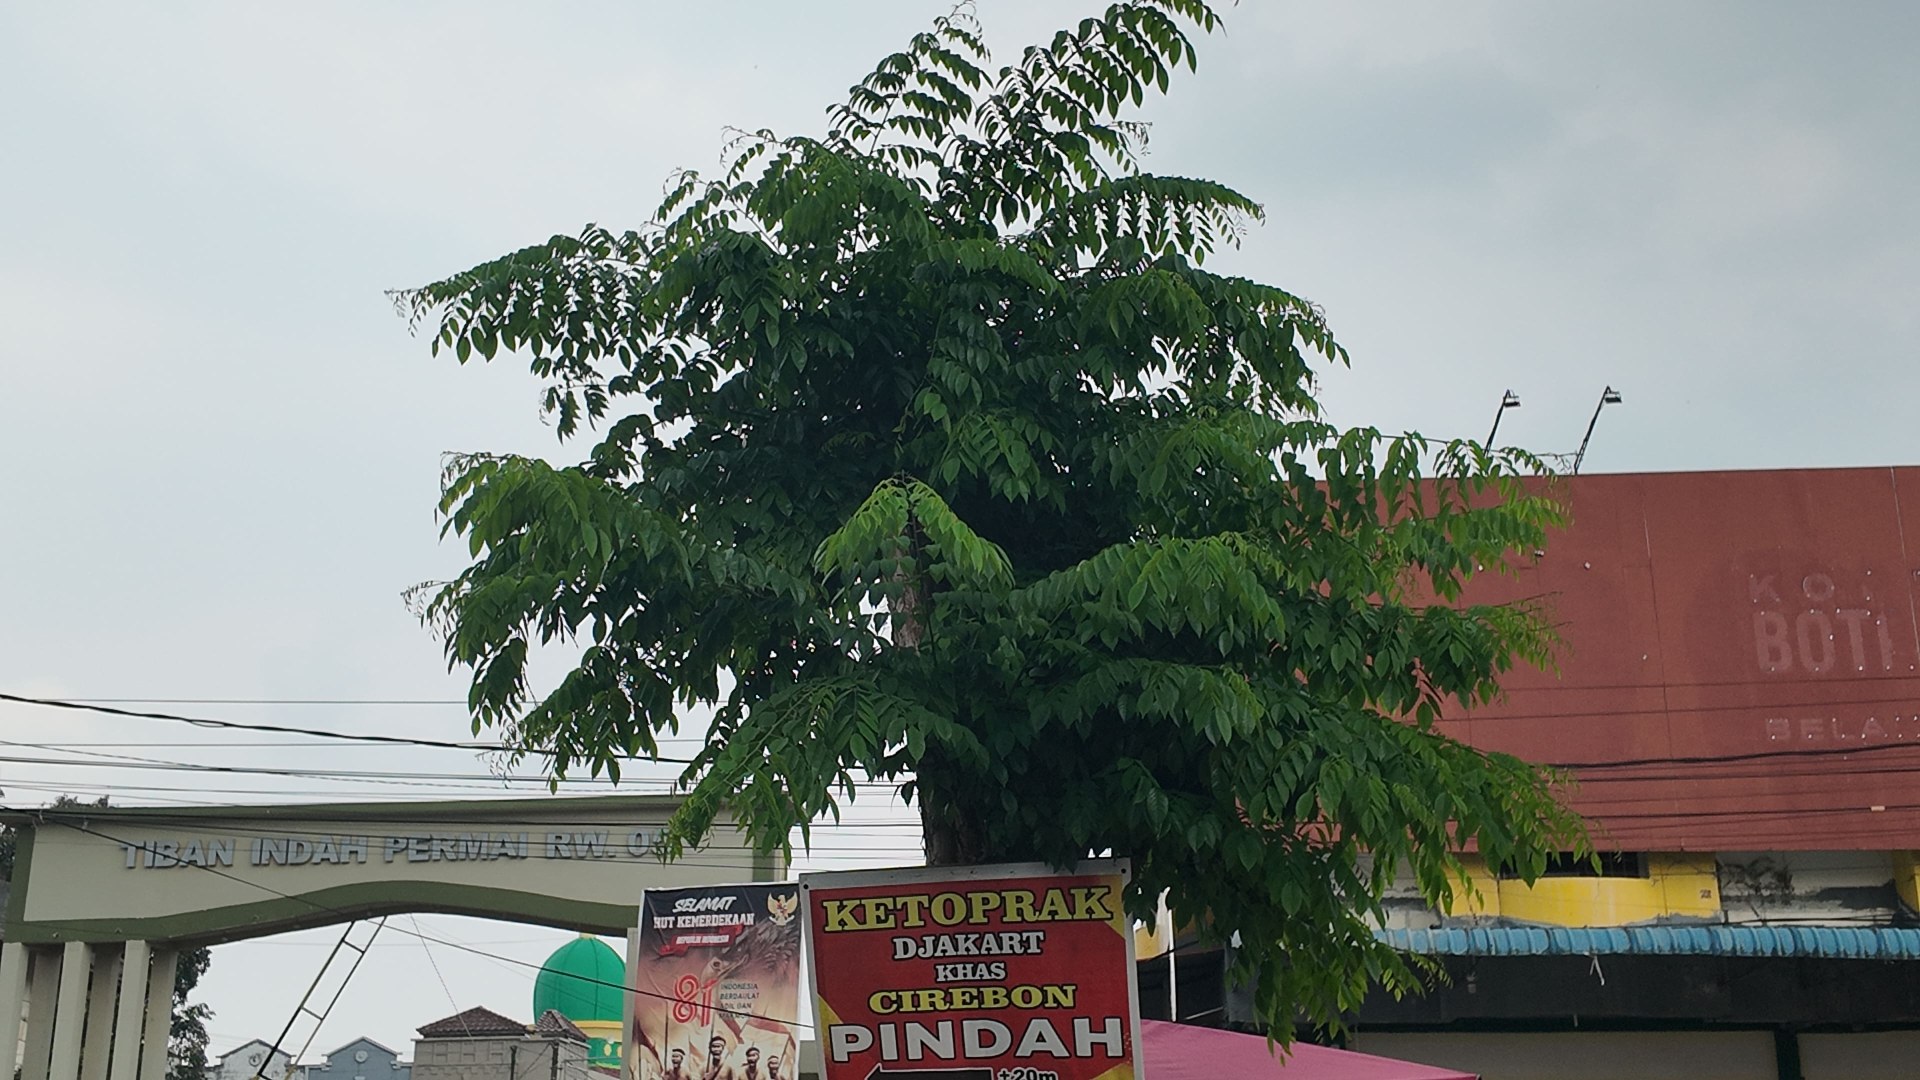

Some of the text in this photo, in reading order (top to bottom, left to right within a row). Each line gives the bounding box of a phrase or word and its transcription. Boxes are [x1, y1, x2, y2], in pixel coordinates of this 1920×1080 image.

[120, 838, 236, 868] TIBAN
[251, 836, 367, 866] INDAH
[383, 831, 528, 862] PERMAI
[546, 830, 616, 858] RW.
[672, 897, 736, 912] SELAMAT
[822, 887, 1112, 931] KETOPRAK
[654, 913, 755, 928] HUT KEMERDEKAAN
[893, 932, 1044, 959] DJAKART
[936, 963, 1005, 982] KHAS
[869, 985, 1076, 1013] CIREBON
[830, 1018, 1123, 1062] PINDAH
